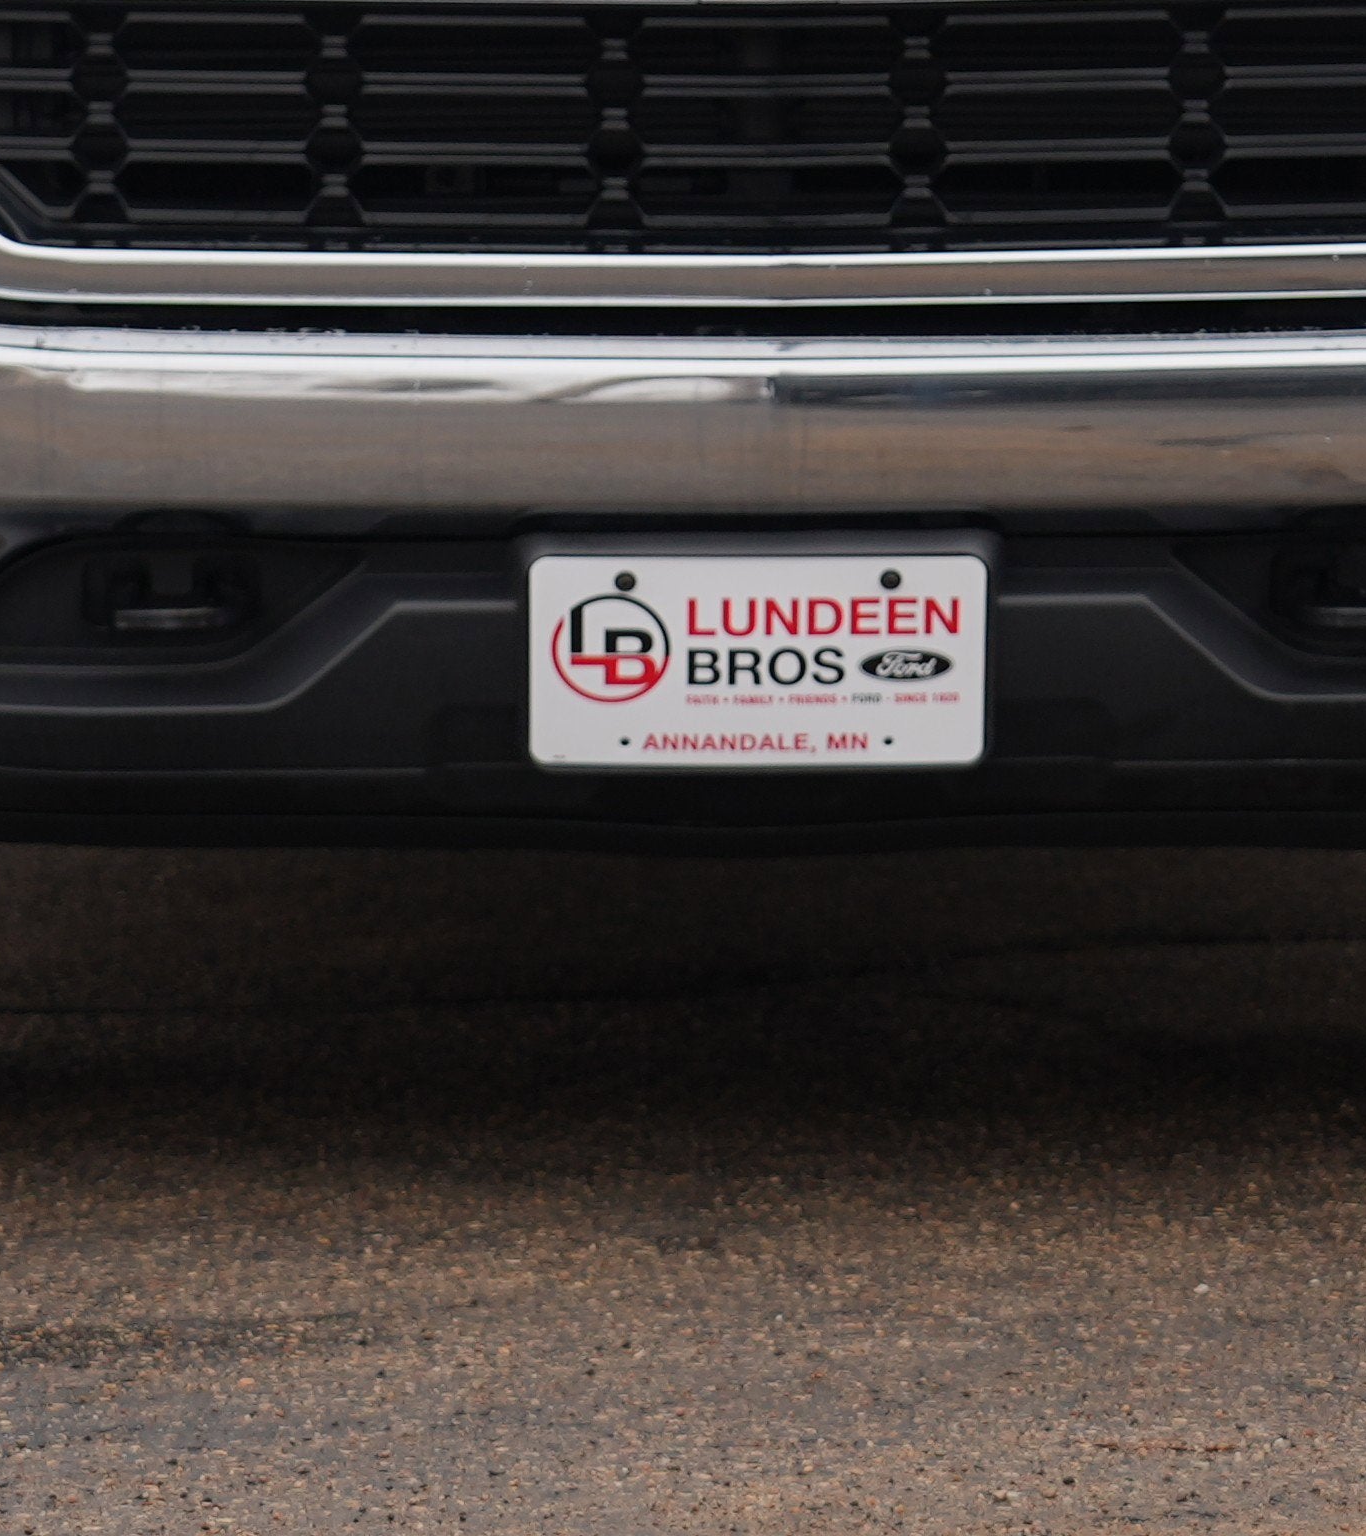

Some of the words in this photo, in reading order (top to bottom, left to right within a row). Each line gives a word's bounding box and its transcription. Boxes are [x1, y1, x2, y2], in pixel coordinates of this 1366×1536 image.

[687, 596, 961, 638] LUNDEEN
[687, 646, 846, 687] BROS
[874, 651, 939, 679] Ford
[642, 732, 817, 754] ANNANDALE,
[826, 732, 869, 751] MN
